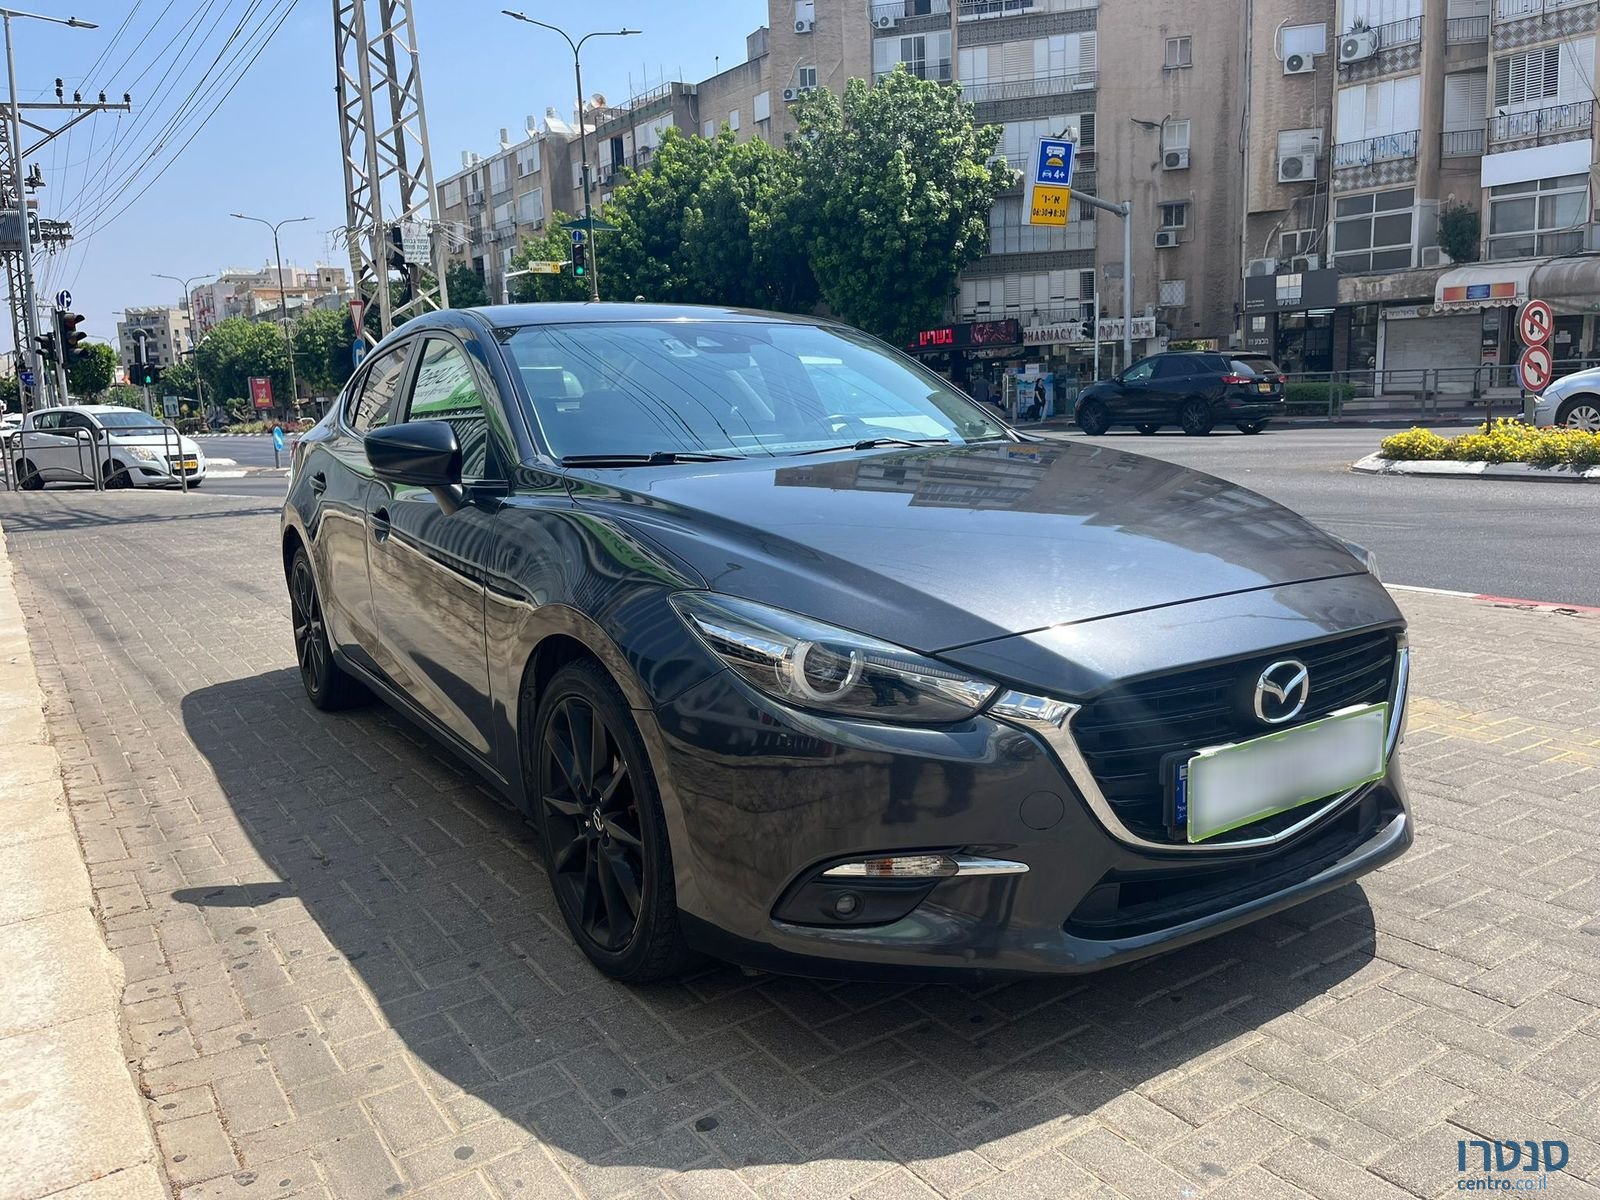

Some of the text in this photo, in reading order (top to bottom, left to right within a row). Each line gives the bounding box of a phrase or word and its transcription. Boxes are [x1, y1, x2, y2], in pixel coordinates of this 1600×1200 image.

[1053, 169, 1065, 179] 4+
[1023, 328, 1073, 342] PHARMACY
[1132, 322, 1152, 337] בית
[919, 328, 953, 346] בשרים
[1254, 338, 1269, 346] מבצע
